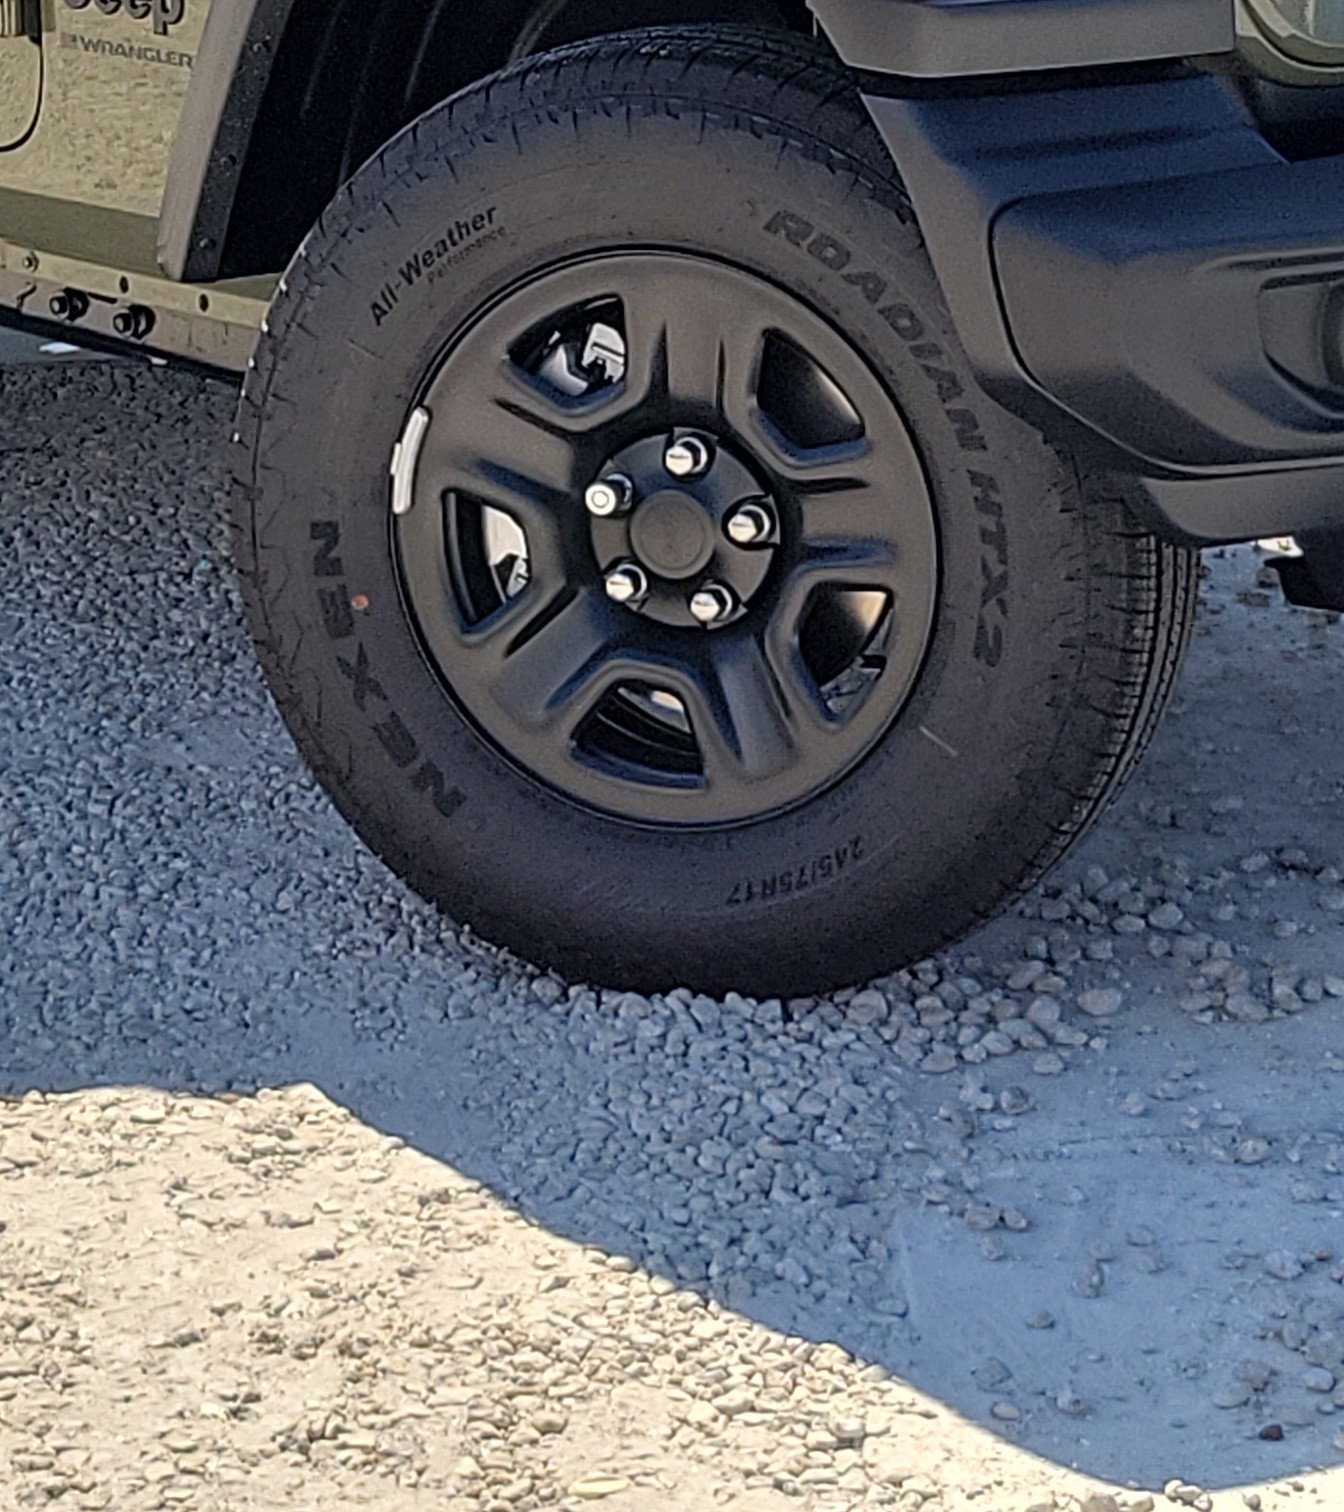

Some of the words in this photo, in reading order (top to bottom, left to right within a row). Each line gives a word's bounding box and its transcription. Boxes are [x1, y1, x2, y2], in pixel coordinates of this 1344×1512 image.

[79, 35, 194, 69] WRANGLER
[370, 206, 496, 327] All-Weather
[763, 209, 989, 453] ROADIAN
[965, 468, 1010, 669] HTX2
[309, 519, 468, 819] NEXEN
